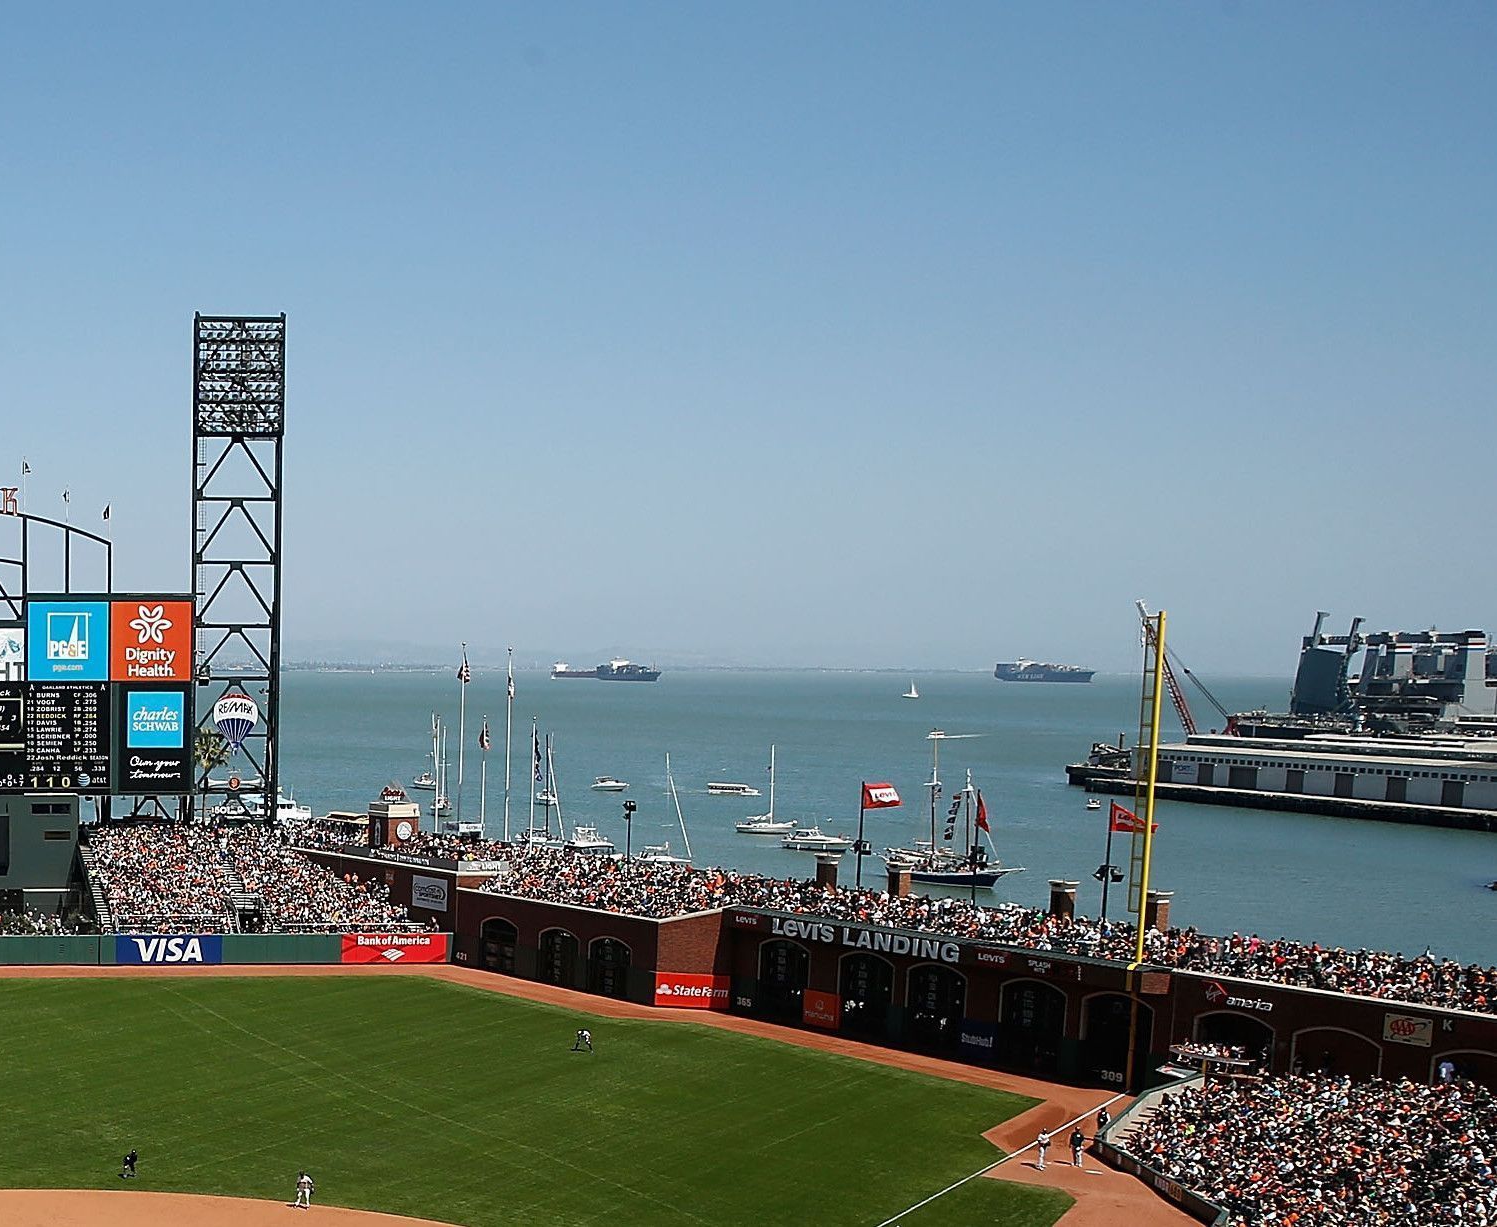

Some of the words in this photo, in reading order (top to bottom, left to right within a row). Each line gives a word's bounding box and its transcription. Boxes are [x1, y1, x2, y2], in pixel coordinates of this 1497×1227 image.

[49, 640, 86, 657] PG&E
[125, 648, 175, 665] Dignity
[132, 706, 178, 721] charles
[218, 701, 254, 714] RE/MAX
[132, 722, 179, 731] SCHWAB
[31, 777, 37, 787] 1
[46, 777, 53, 787] 1
[62, 777, 70, 787] 0
[357, 936, 382, 945] Bank
[392, 936, 431, 945] America
[842, 928, 960, 962] LANDING
[132, 938, 203, 962] VISA
[456, 952, 467, 960] 421
[736, 997, 751, 1007] 365
[1226, 997, 1273, 1011] america
[1442, 1019, 1453, 1031] K
[1101, 1069, 1123, 1082] 309
